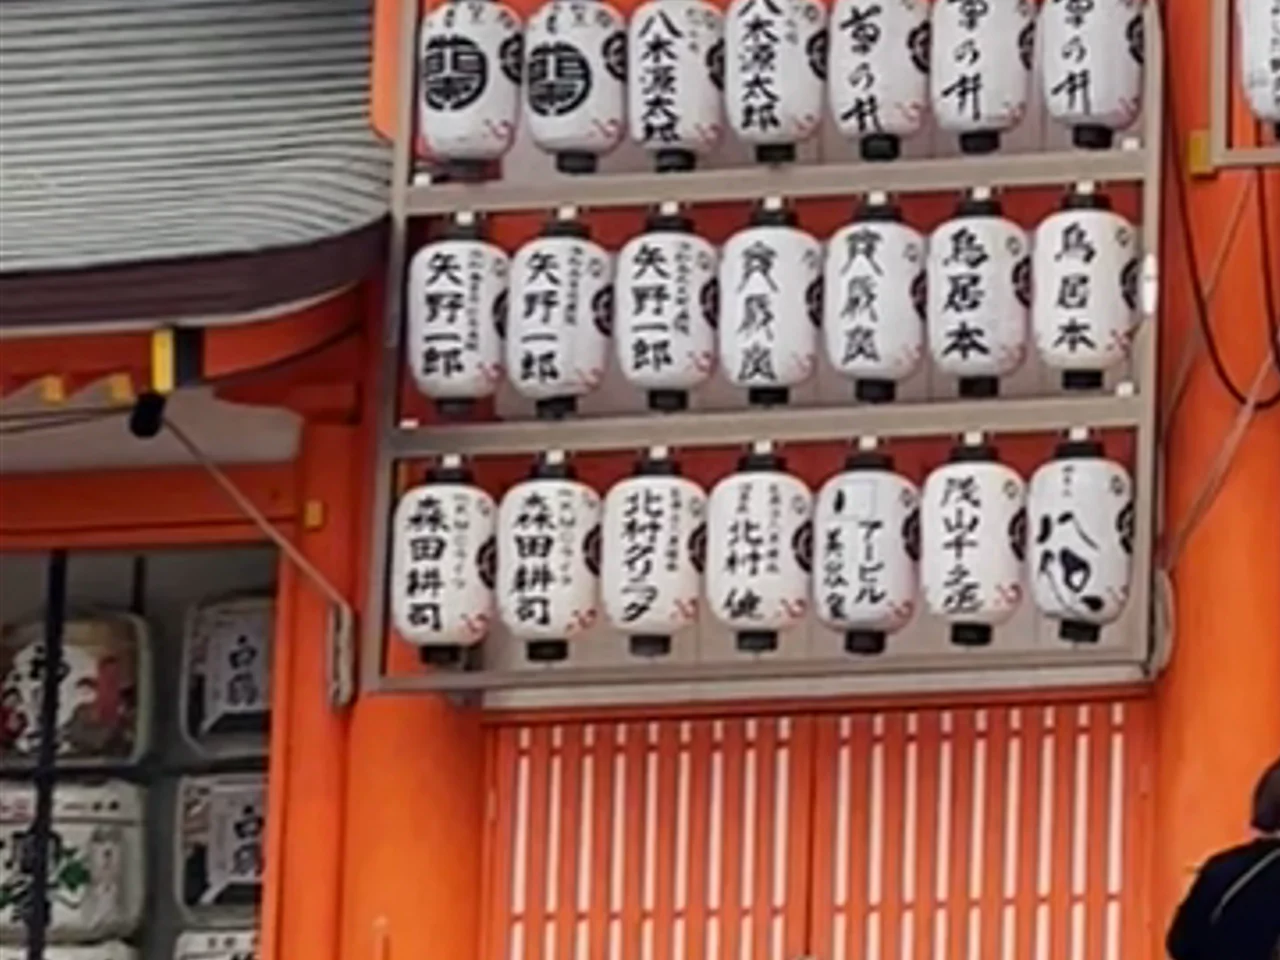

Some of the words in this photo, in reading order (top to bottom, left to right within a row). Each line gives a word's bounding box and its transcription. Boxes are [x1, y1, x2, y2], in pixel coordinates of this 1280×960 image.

[421, 251, 465, 377] 矢野一郎
[520, 251, 562, 382] 矢野一郎
[631, 244, 674, 372] 矢野一郎
[405, 496, 451, 632] 森田耕司
[511, 492, 556, 626] 森田耕司
